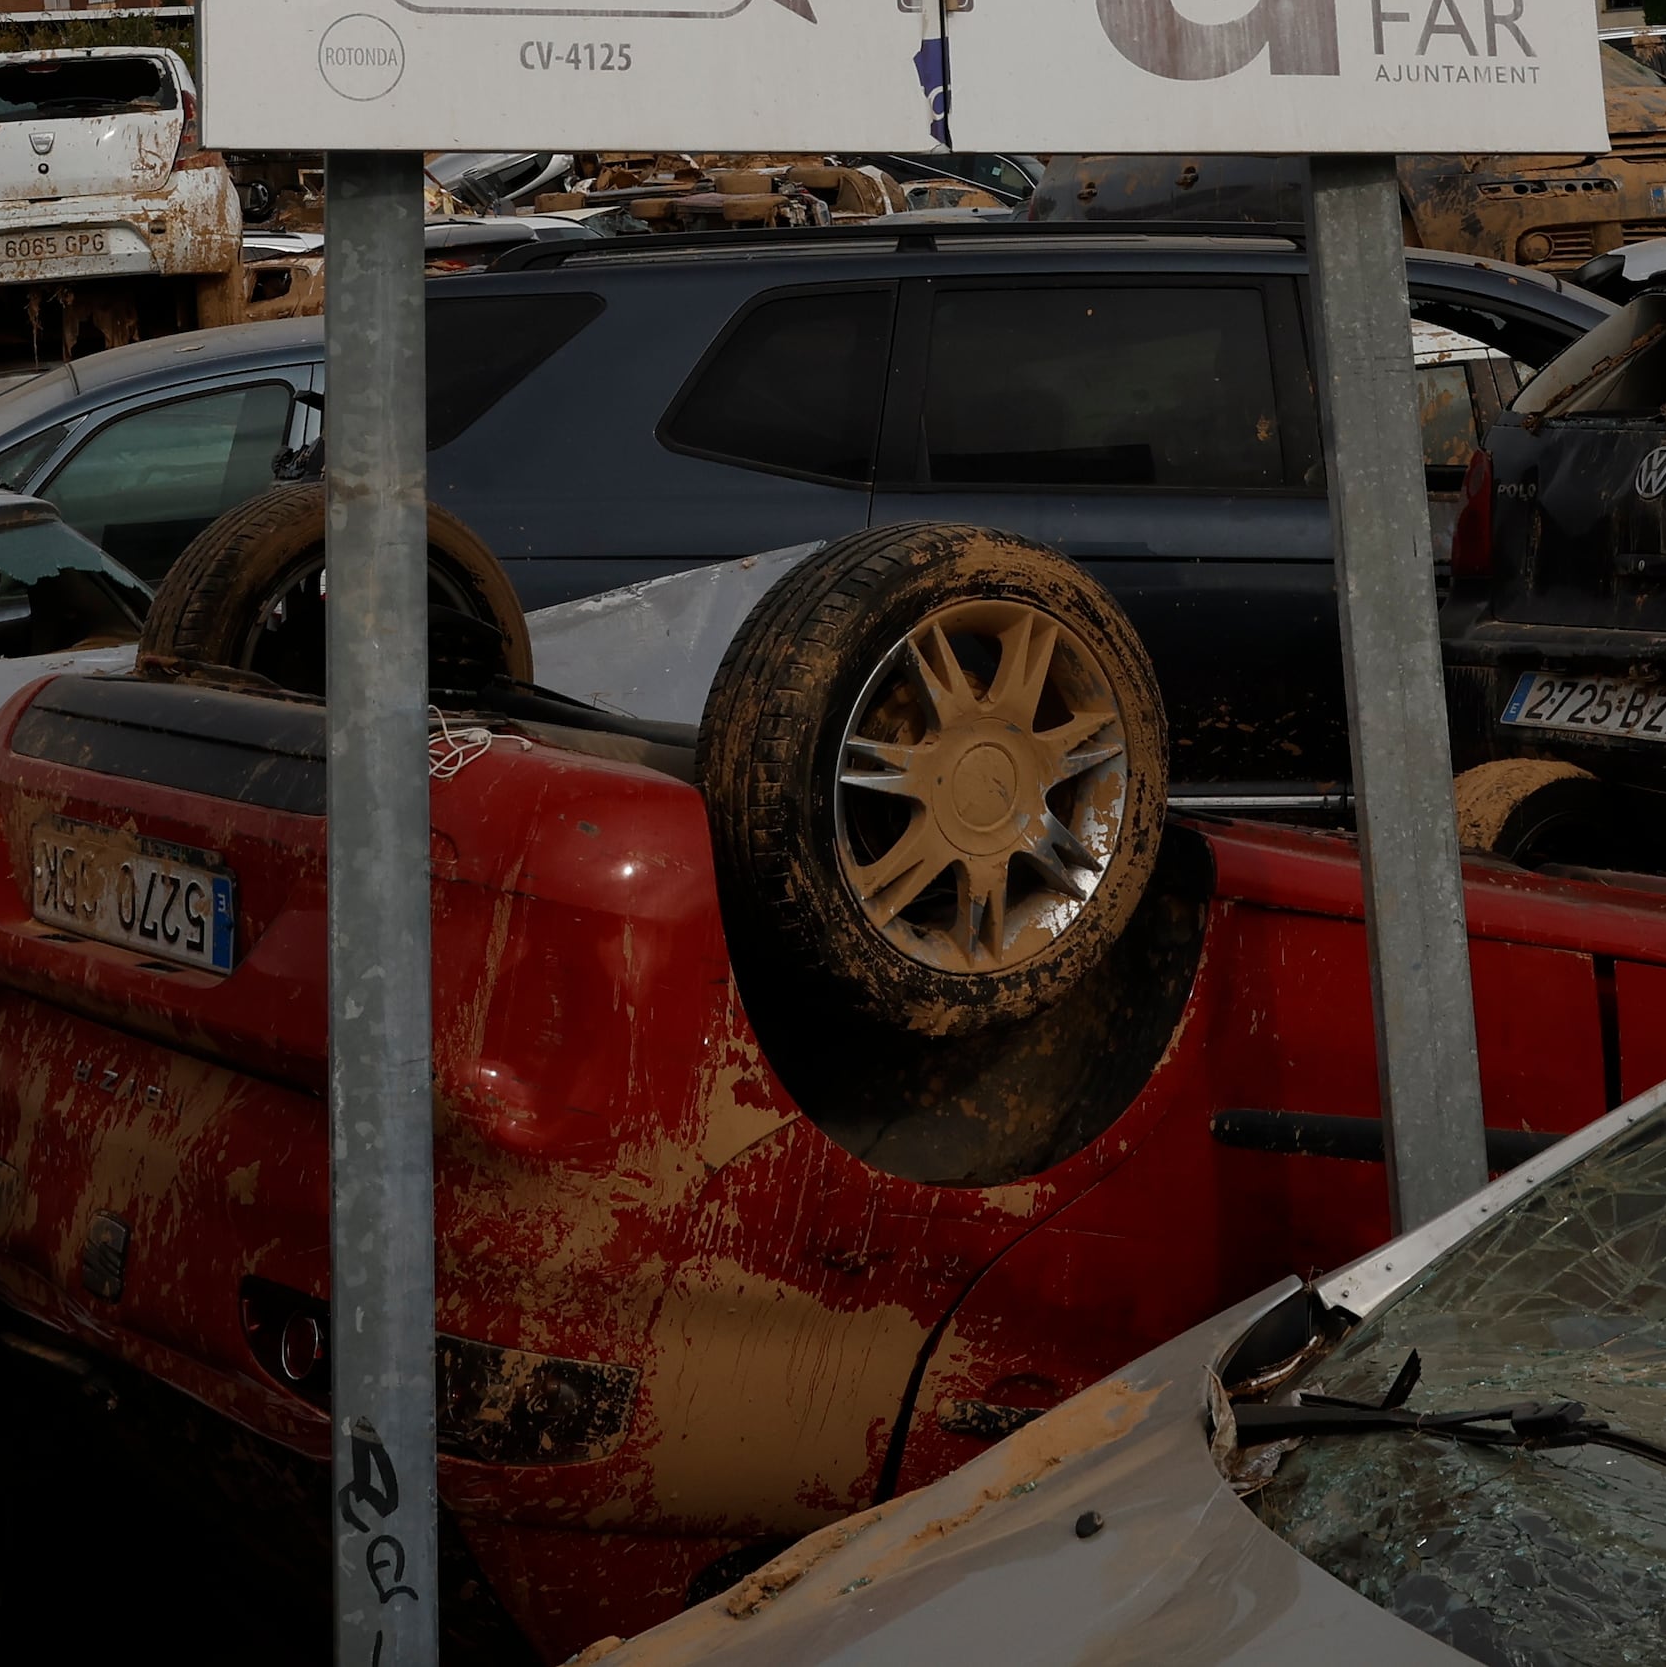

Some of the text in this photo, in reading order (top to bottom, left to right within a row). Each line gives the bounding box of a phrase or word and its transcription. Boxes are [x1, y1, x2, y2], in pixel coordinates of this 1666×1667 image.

[325, 46, 399, 67] ROTONDA
[519, 40, 632, 72] CV-4125
[1375, 64, 1541, 85] AJUNTAMENT
[5, 233, 104, 258] 6065 GPG
[1497, 483, 1537, 499] POLO
[1524, 680, 1613, 725] 2725
[118, 862, 205, 952] 5270
